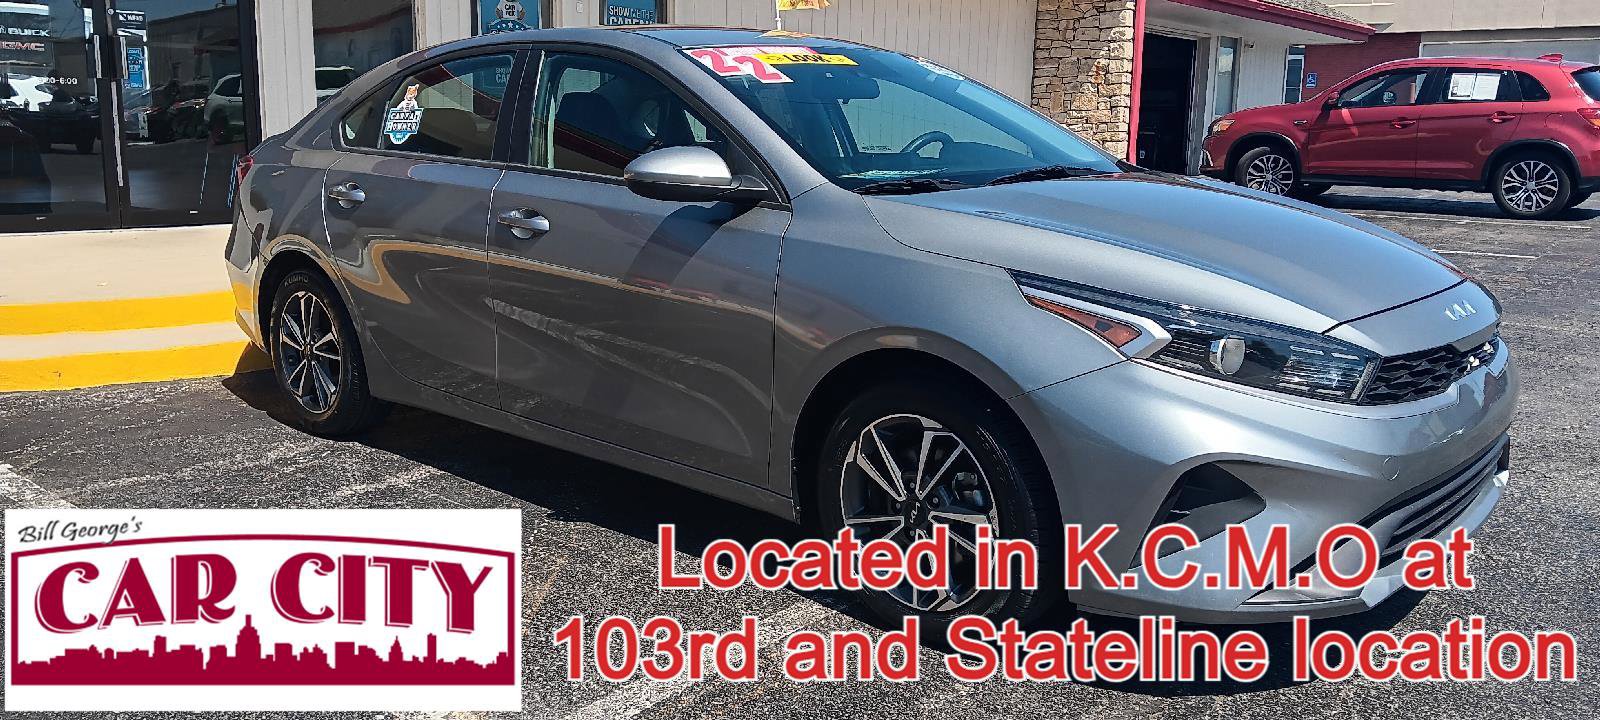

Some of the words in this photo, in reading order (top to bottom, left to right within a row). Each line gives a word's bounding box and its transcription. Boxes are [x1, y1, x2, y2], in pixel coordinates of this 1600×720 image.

[608, 5, 630, 17] SHOW
[7, 27, 51, 37] BUICK
[2, 41, 45, 52] GMC
[783, 54, 831, 63] LOOK
[284, 273, 309, 287] KUMHO
